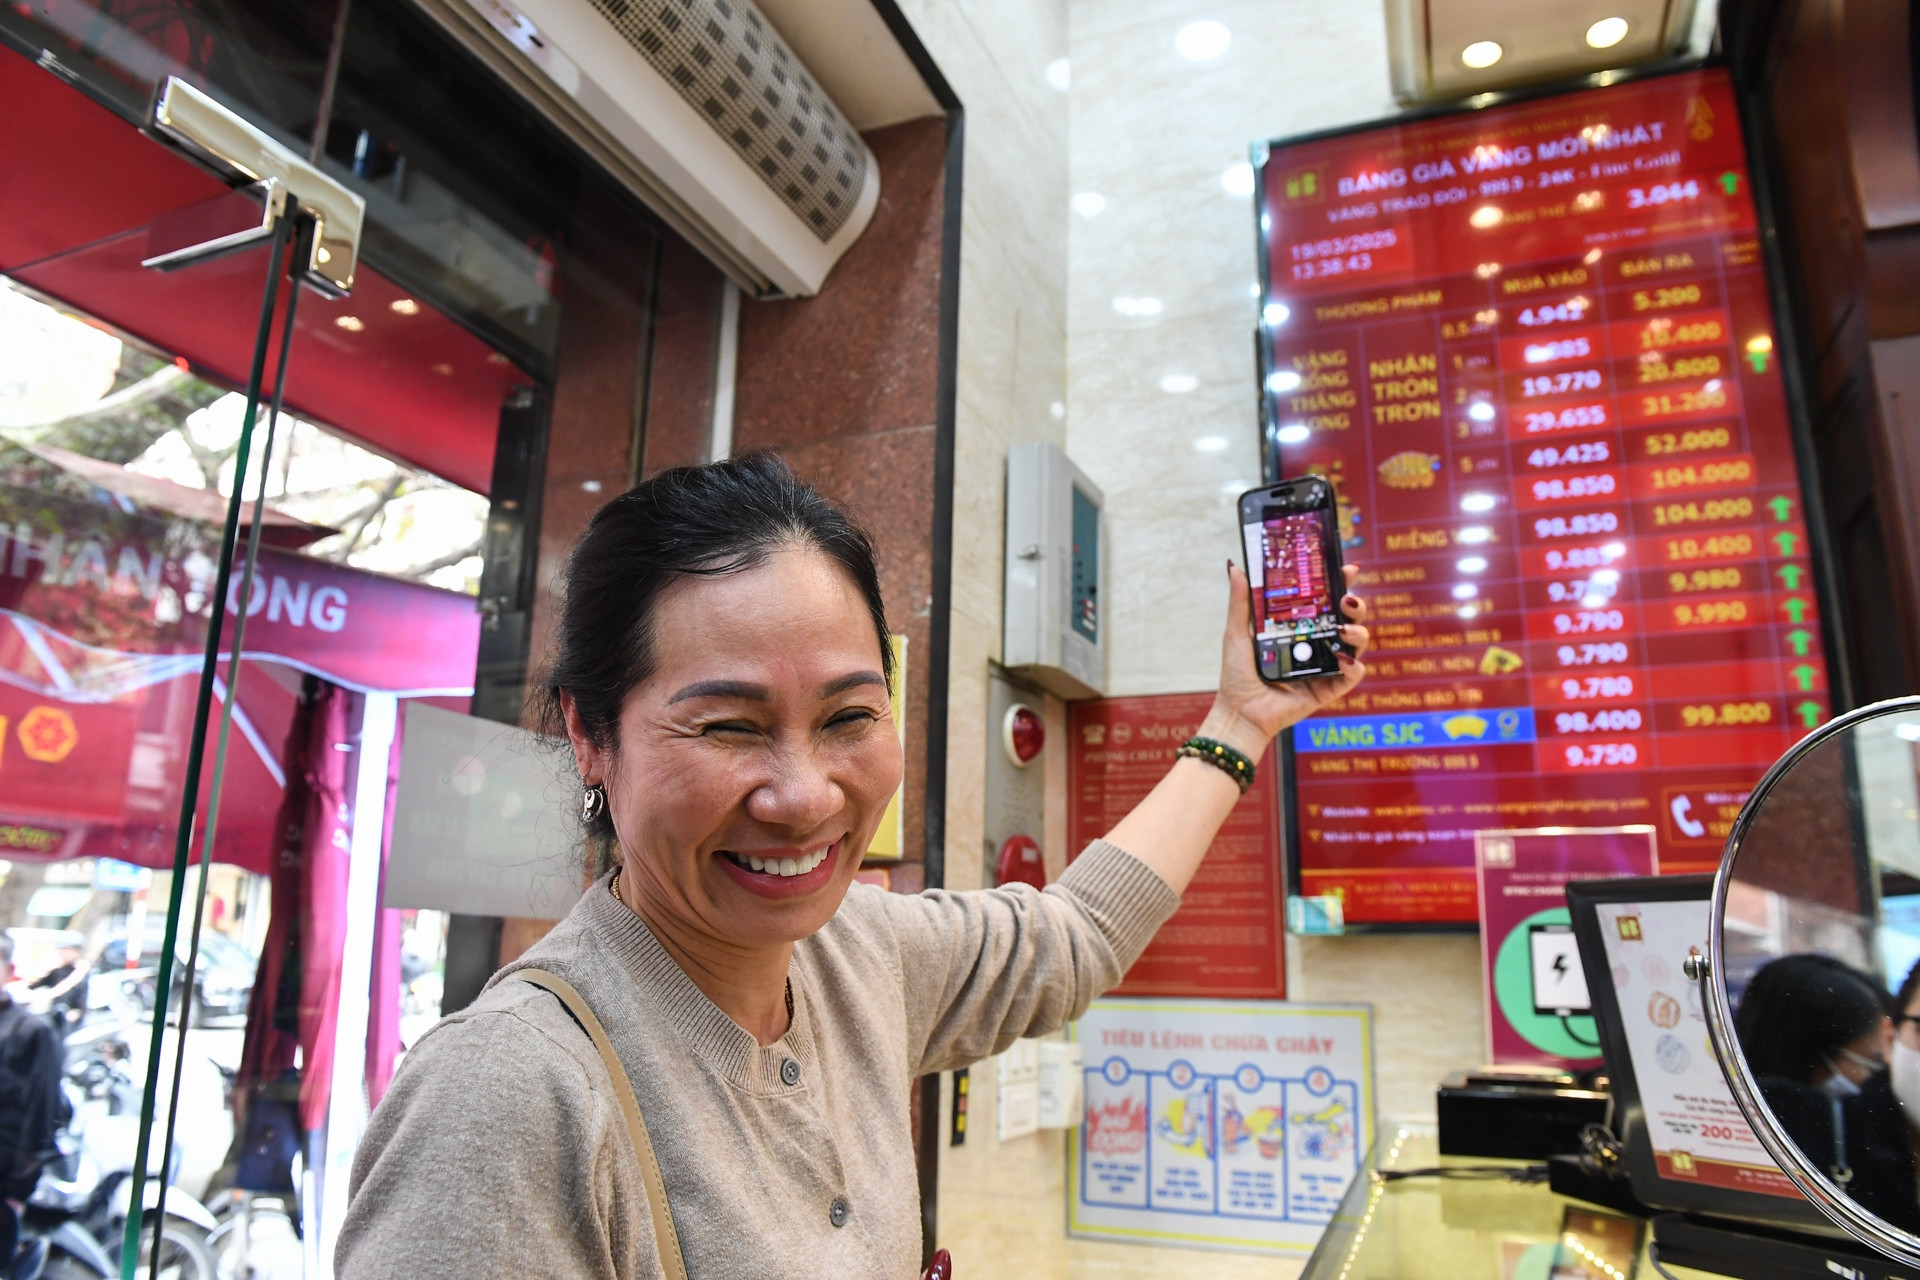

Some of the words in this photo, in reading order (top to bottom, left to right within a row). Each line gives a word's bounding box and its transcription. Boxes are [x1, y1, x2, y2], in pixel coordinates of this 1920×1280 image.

[1627, 178, 1700, 209] 3.044
[1664, 252, 1695, 271] RA
[1632, 284, 1701, 312] 5.200
[1641, 320, 1722, 349] 10.400
[1524, 336, 1591, 364] 885
[1639, 354, 1721, 384] 20.800
[1522, 369, 1602, 397] 19.770
[1525, 404, 1606, 433] 29.655
[1527, 441, 1611, 468] 49.425
[1645, 427, 1730, 456] 52.000
[1532, 474, 1616, 501] 98.850
[1651, 460, 1751, 490] 104.000
[1534, 512, 1618, 539] 98.850
[1653, 497, 1753, 527] 104.000
[1667, 534, 1752, 561] 10.400
[1669, 567, 1741, 595] 9.980
[1554, 610, 1624, 634] 9.790
[1674, 601, 1746, 626] 9.990
[1557, 641, 1628, 667] 9.790
[1562, 675, 1633, 700] 9.780
[1555, 708, 1642, 734] 98.400
[1682, 701, 1772, 727] 99.800
[1309, 720, 1375, 749] VÀNG
[1382, 722, 1424, 746] SJC
[1565, 743, 1638, 768] 9.750
[1311, 1072, 1325, 1088] 4
[1700, 1123, 1733, 1140] 200
